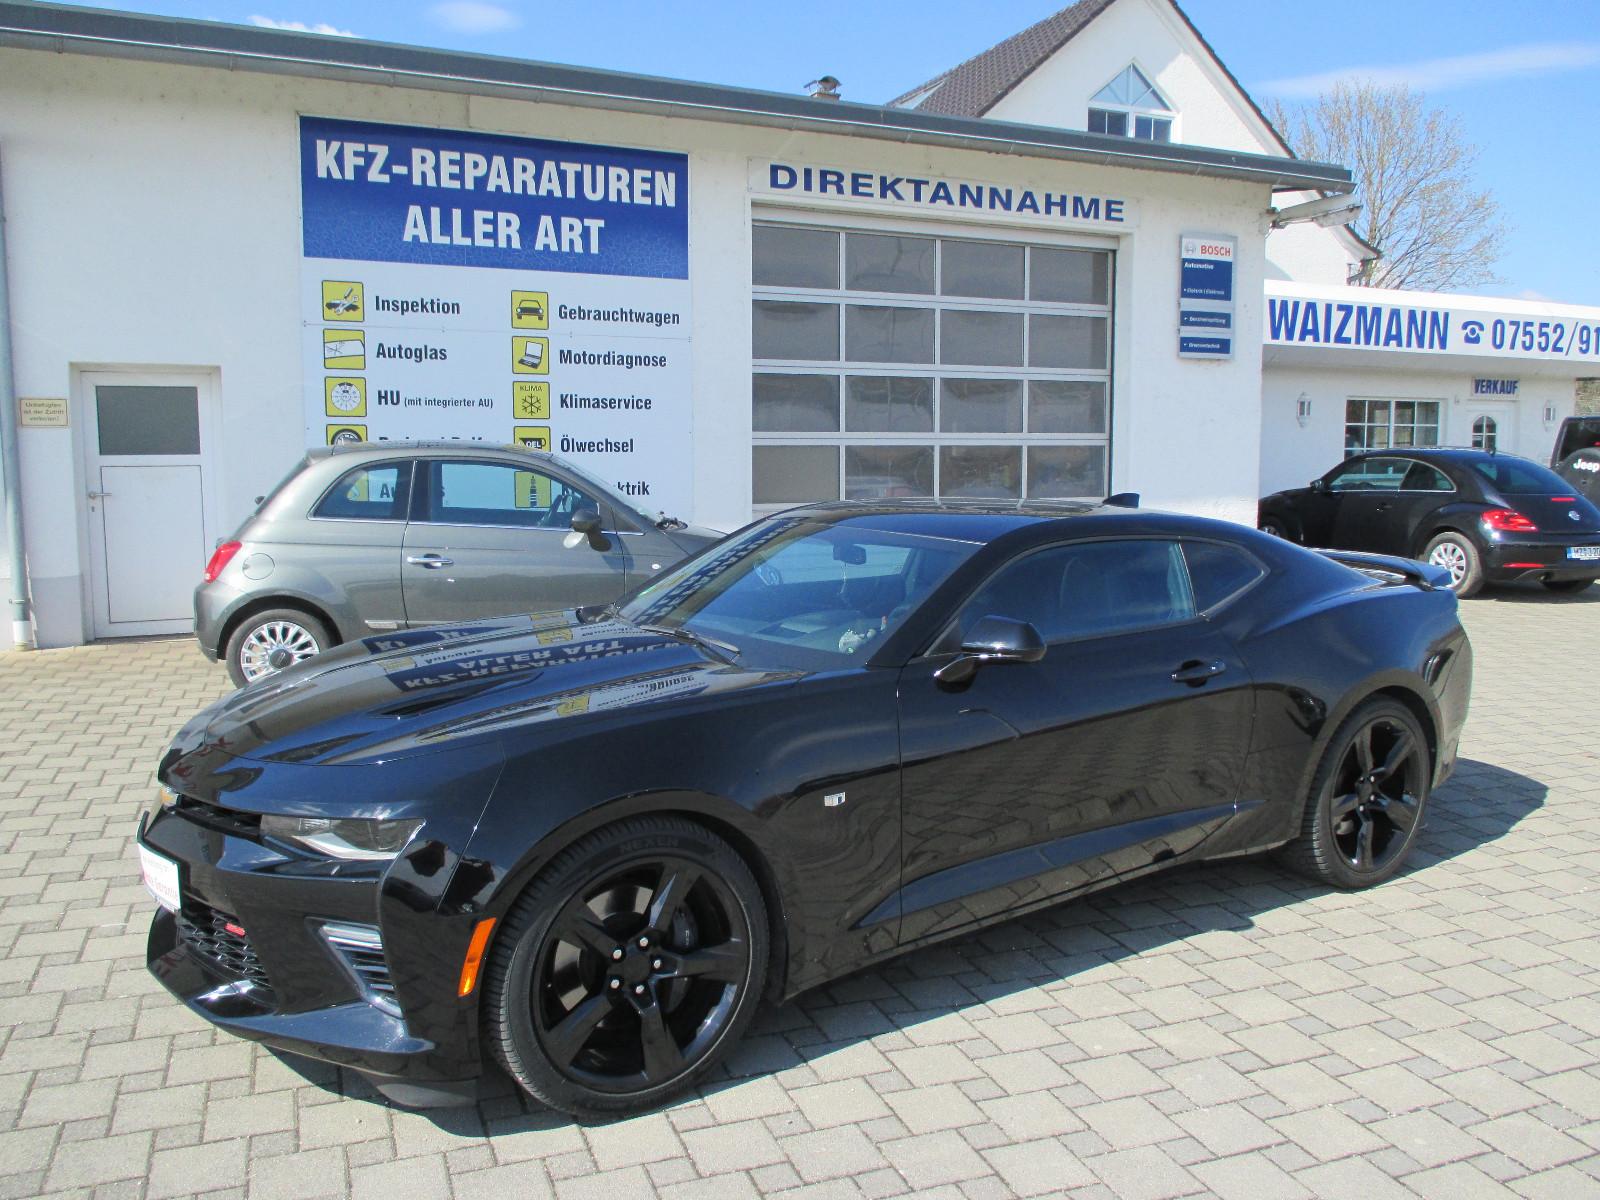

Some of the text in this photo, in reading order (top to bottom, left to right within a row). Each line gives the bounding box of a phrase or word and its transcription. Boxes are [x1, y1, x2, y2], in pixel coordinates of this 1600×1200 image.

[315, 139, 676, 208] KFZ-REPARATUREN
[769, 163, 1125, 222] DIREKTANNAHME
[402, 204, 605, 255] ALLER ART
[1200, 244, 1231, 257] BOSCH
[375, 295, 461, 315] Inspektion
[558, 304, 680, 327] Gebrauchtwagen
[1268, 298, 1450, 350] WAIZMANN
[376, 342, 448, 363] Autoglas
[559, 349, 667, 369] Motordiagnose
[519, 384, 543, 392] KLIMA
[1474, 378, 1519, 395] VERKAUF
[377, 390, 494, 408] HU (mit integrierter AU)
[559, 393, 652, 410] Klimaservice
[560, 434, 634, 453] Ölwechsel
[1573, 458, 1600, 473] Jeep
